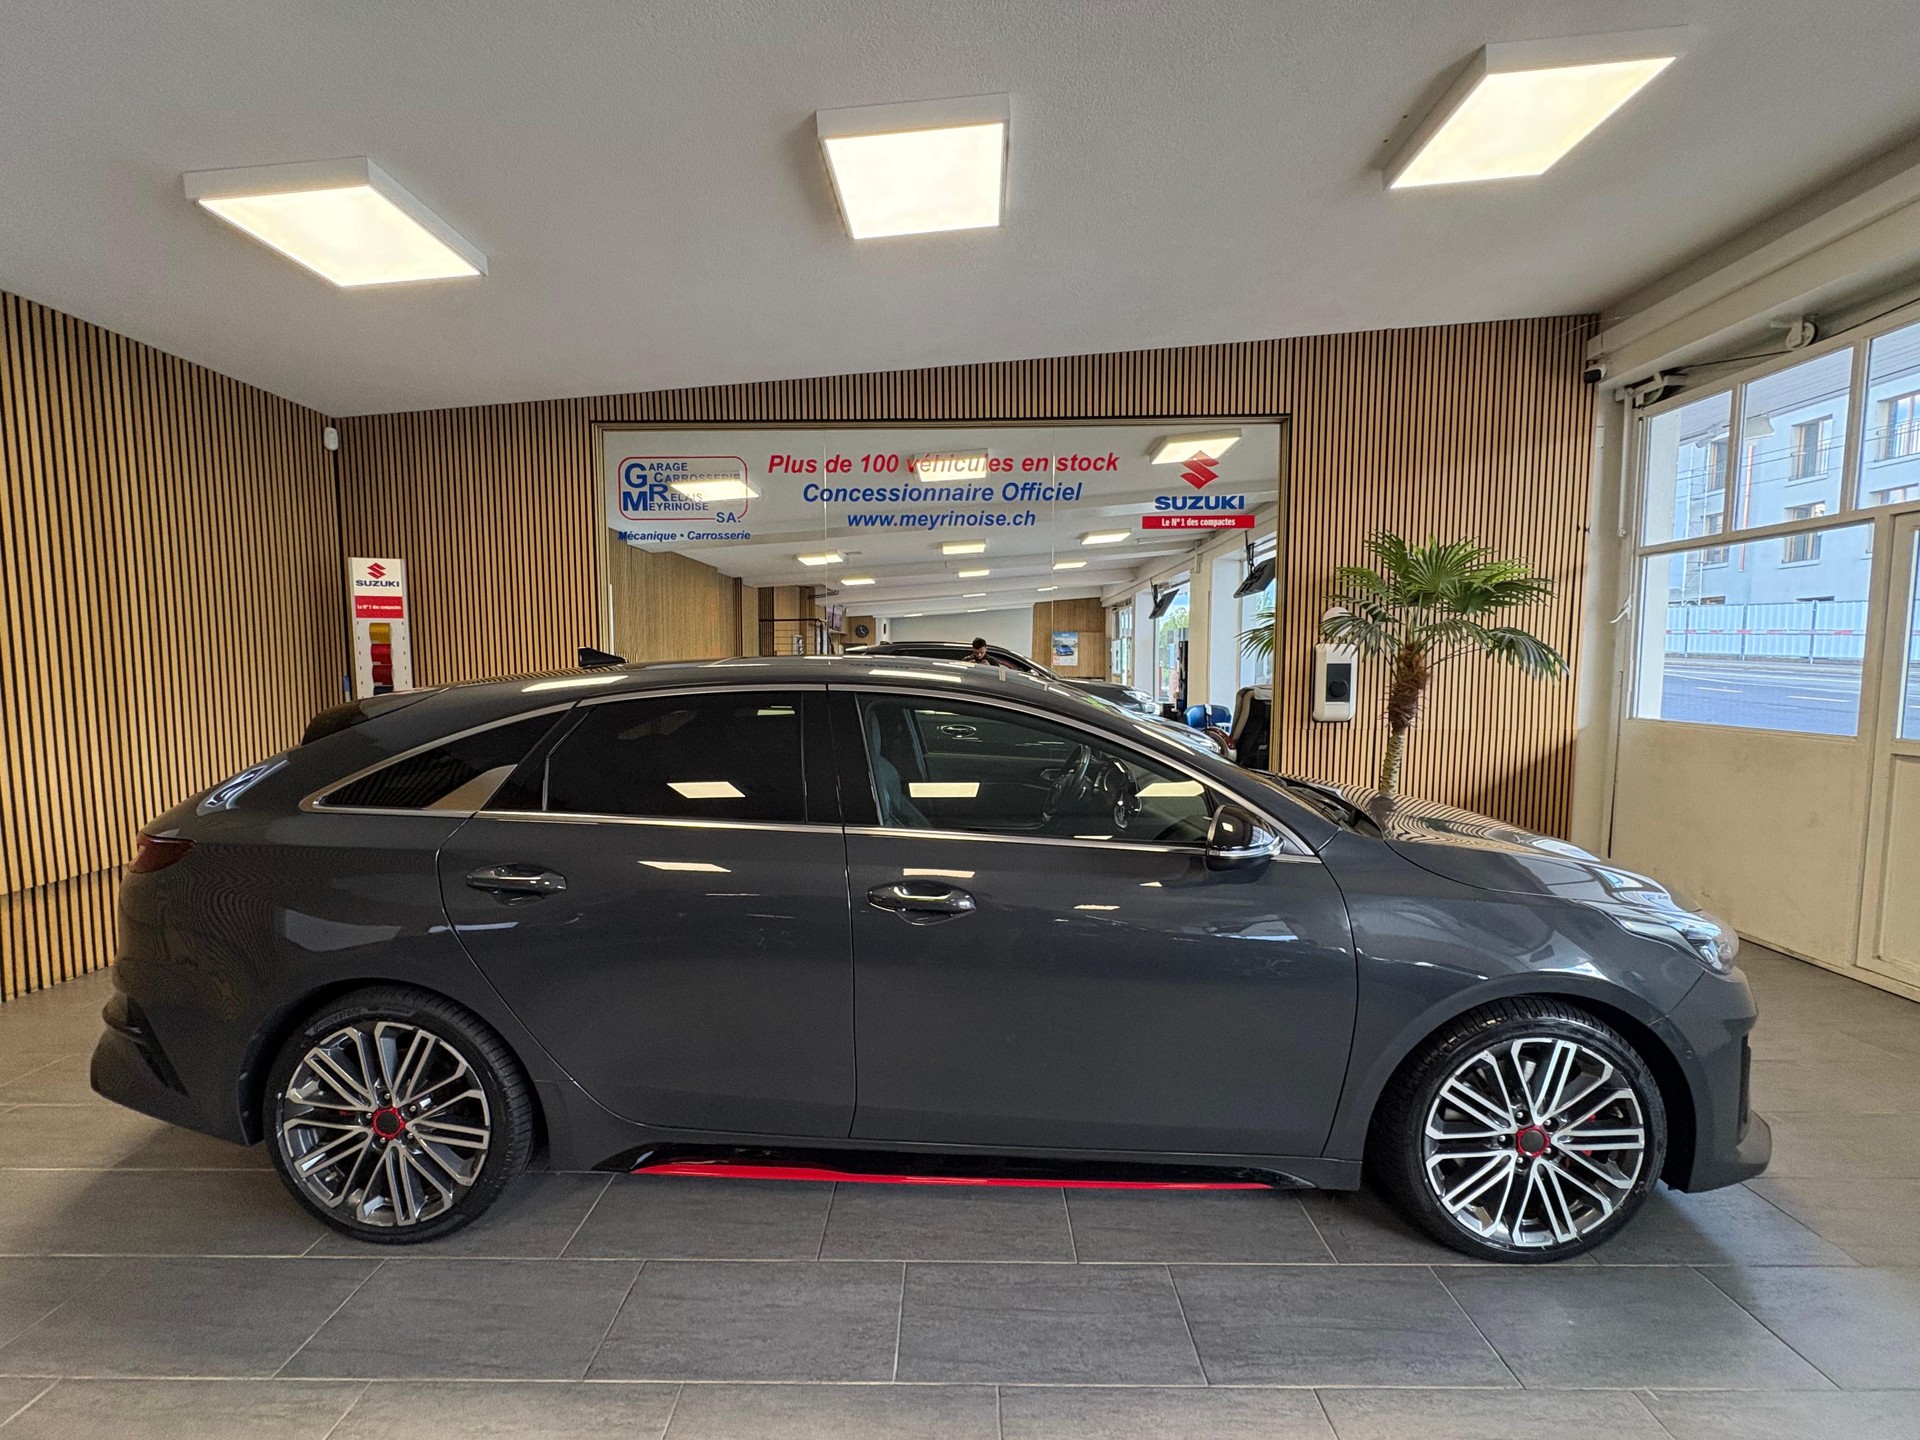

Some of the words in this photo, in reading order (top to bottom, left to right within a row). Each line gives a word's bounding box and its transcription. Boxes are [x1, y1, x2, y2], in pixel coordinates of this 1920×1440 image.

[768, 454, 817, 474] Plus
[825, 454, 852, 473] de
[860, 453, 899, 473] 100
[906, 453, 1014, 473] véhicules
[1021, 457, 1048, 472] en
[1055, 452, 1120, 472] stock
[624, 462, 688, 488] GARAGE
[622, 491, 709, 511] MEYRINOISE
[803, 483, 994, 502] Concessionnaire
[1002, 482, 1083, 501] Officiel
[1154, 495, 1245, 511] SUZUKI
[847, 510, 1036, 531] www.meyrinoise.ch
[1161, 518, 1170, 527] Le
[1186, 518, 1199, 527] des
[1200, 518, 1236, 528] compactes
[617, 531, 677, 543] Mécanique
[687, 530, 751, 541] Carrosserie
[355, 579, 400, 587] SUZUKI
